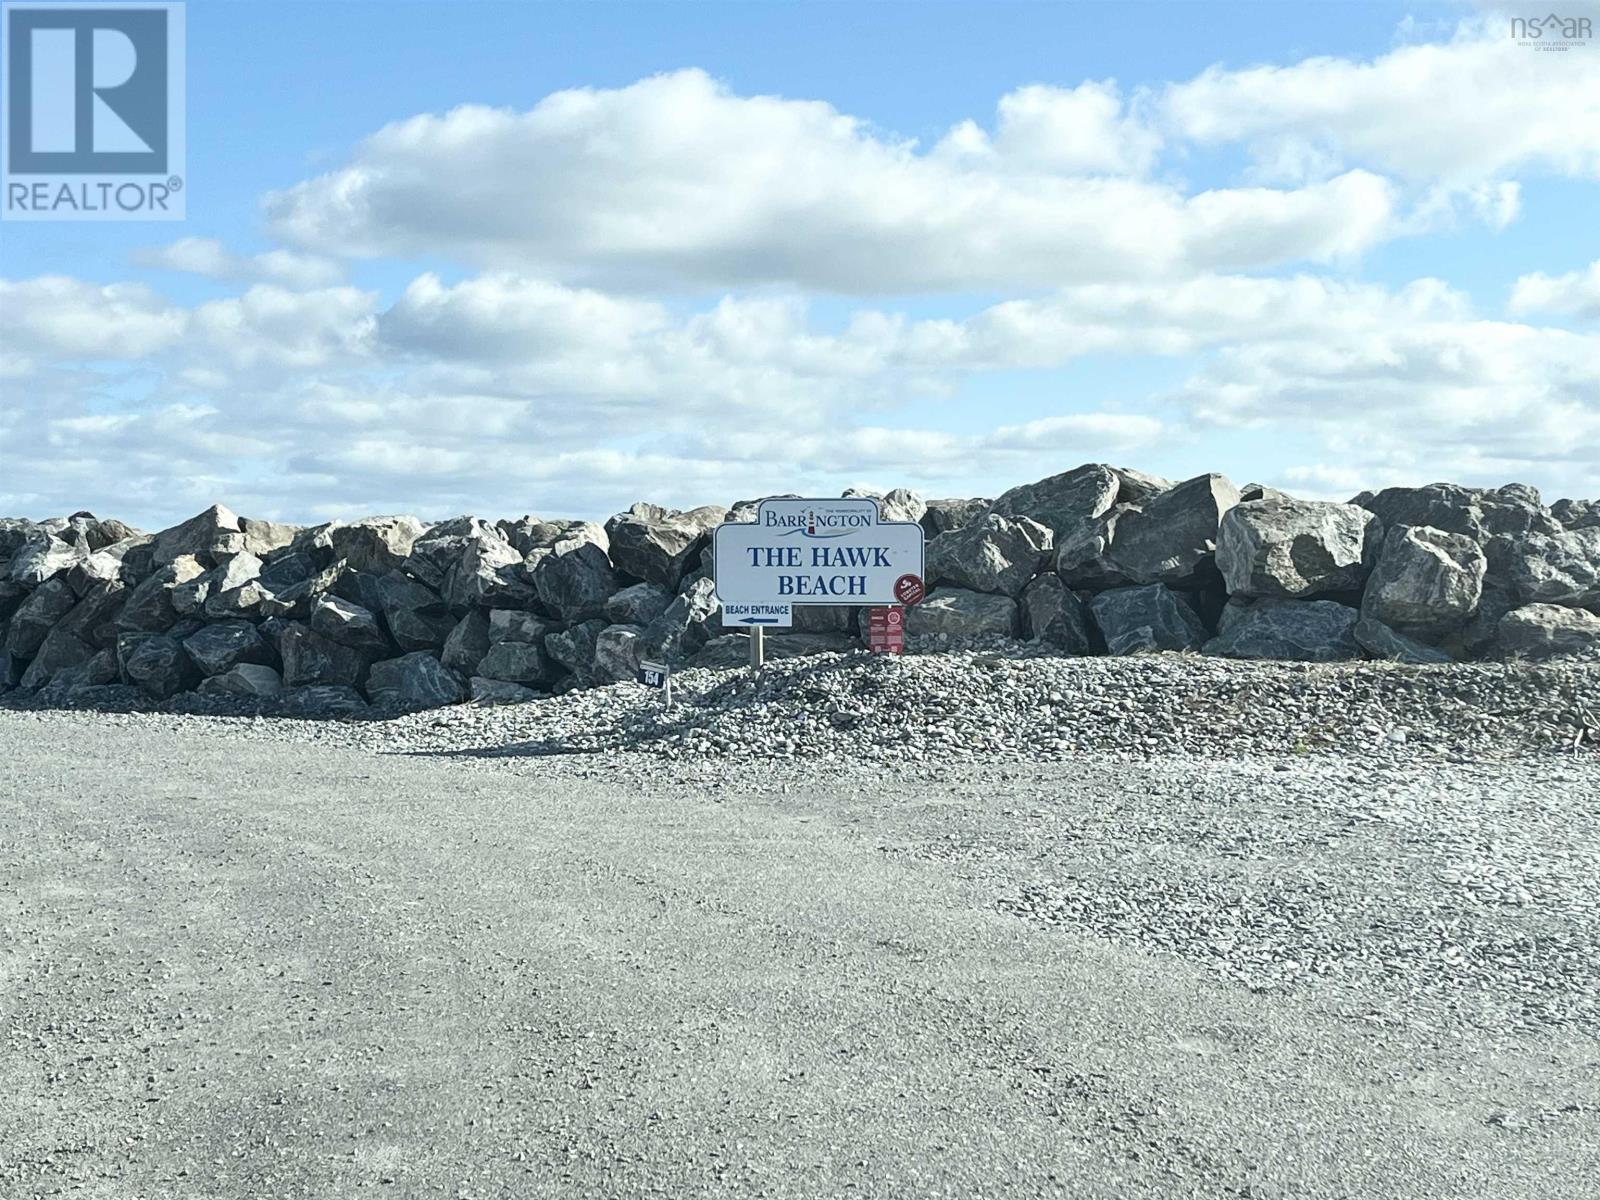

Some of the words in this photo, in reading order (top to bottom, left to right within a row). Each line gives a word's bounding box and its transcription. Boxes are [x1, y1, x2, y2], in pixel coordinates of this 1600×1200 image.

[747, 547, 802, 567] THE
[811, 547, 892, 567] HAWK
[778, 575, 867, 595] BEACH
[725, 605, 749, 615] BEACH
[751, 605, 789, 615] ENTRANCE
[645, 670, 659, 685] 154
